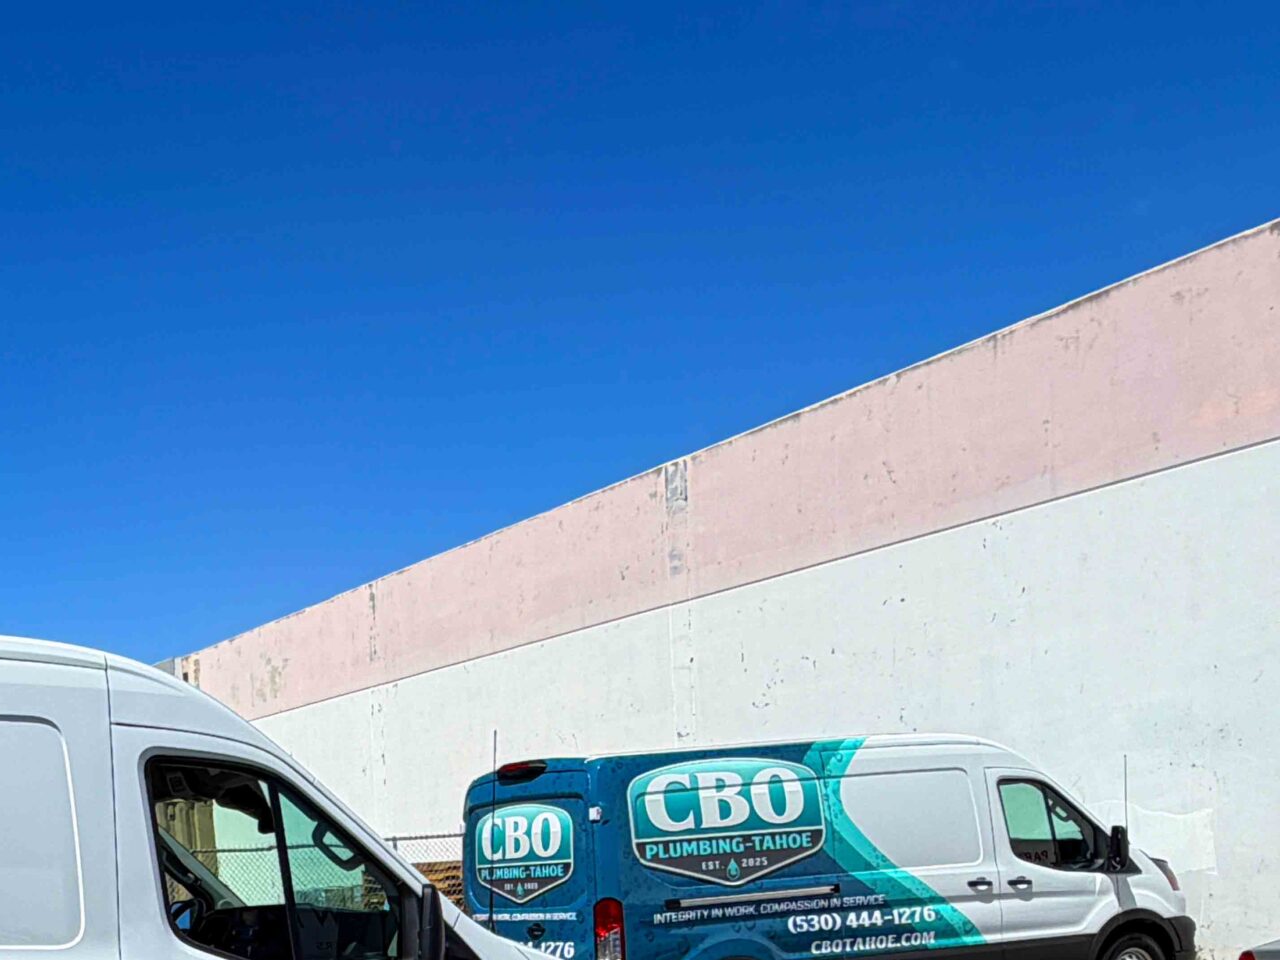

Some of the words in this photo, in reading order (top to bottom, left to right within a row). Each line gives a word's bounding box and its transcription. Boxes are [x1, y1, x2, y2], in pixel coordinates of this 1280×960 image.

[644, 767, 805, 832] CBO
[481, 811, 562, 861] CBO
[645, 832, 812, 859] PLUMBING-TAHOE
[702, 861, 725, 871] EST.
[741, 857, 768, 868] 2025
[653, 908, 709, 924] INTEGRITY
[711, 907, 723, 918] IN
[760, 899, 828, 914] COMPASSION
[830, 897, 841, 908] IN
[843, 894, 885, 907] SERVICE
[787, 912, 841, 934] (530)
[846, 905, 936, 929] 444-1276
[811, 931, 936, 955] CBOTAHOE.COM
